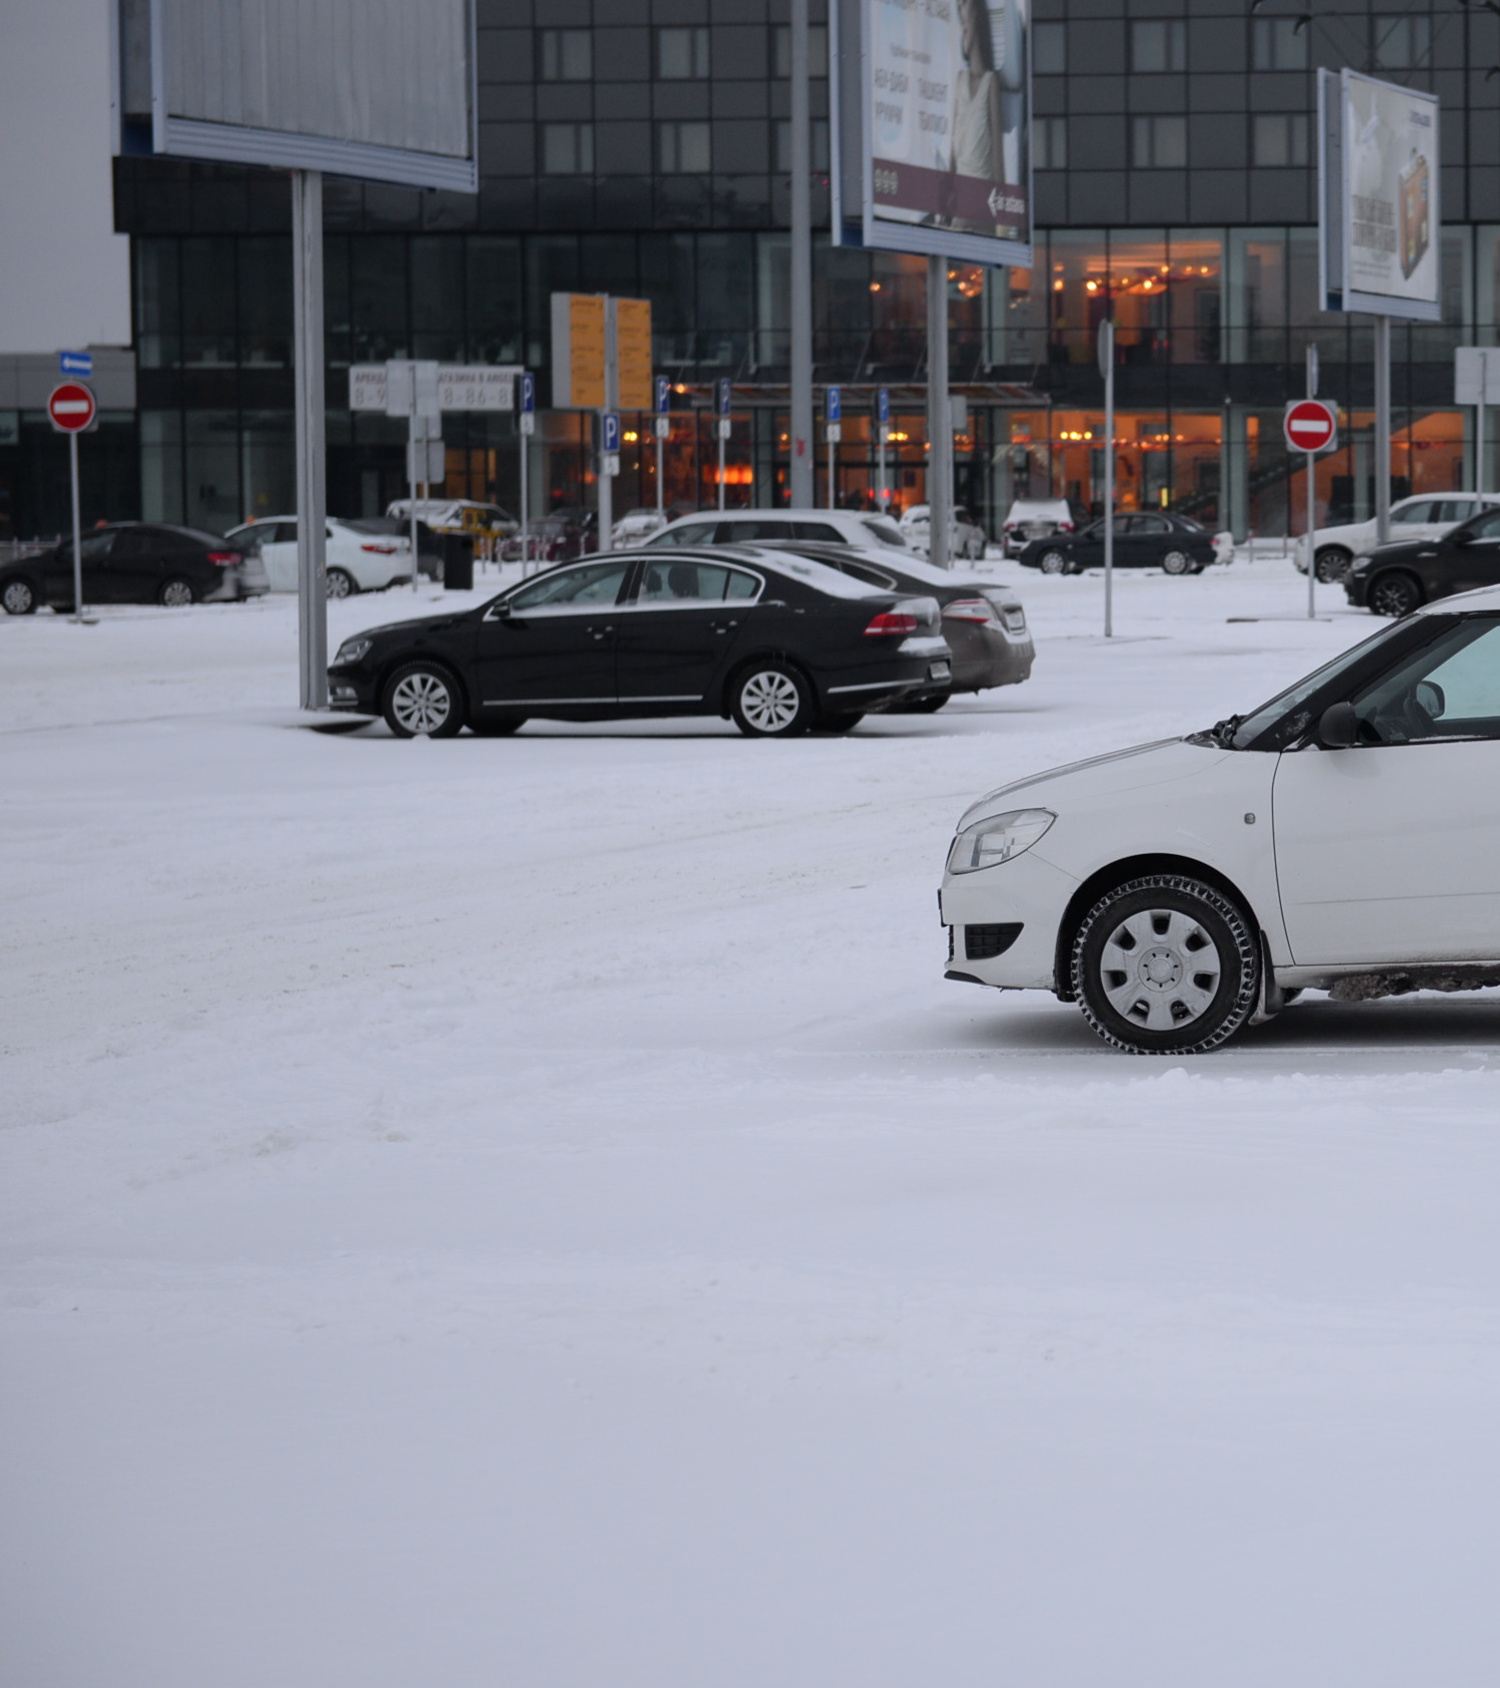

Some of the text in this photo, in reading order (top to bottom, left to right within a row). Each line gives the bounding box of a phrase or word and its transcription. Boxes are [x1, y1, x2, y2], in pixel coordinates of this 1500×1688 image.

[437, 372, 475, 383] АГАЗИНА
[524, 377, 532, 409] P
[660, 380, 667, 410] P
[606, 417, 617, 448] P
